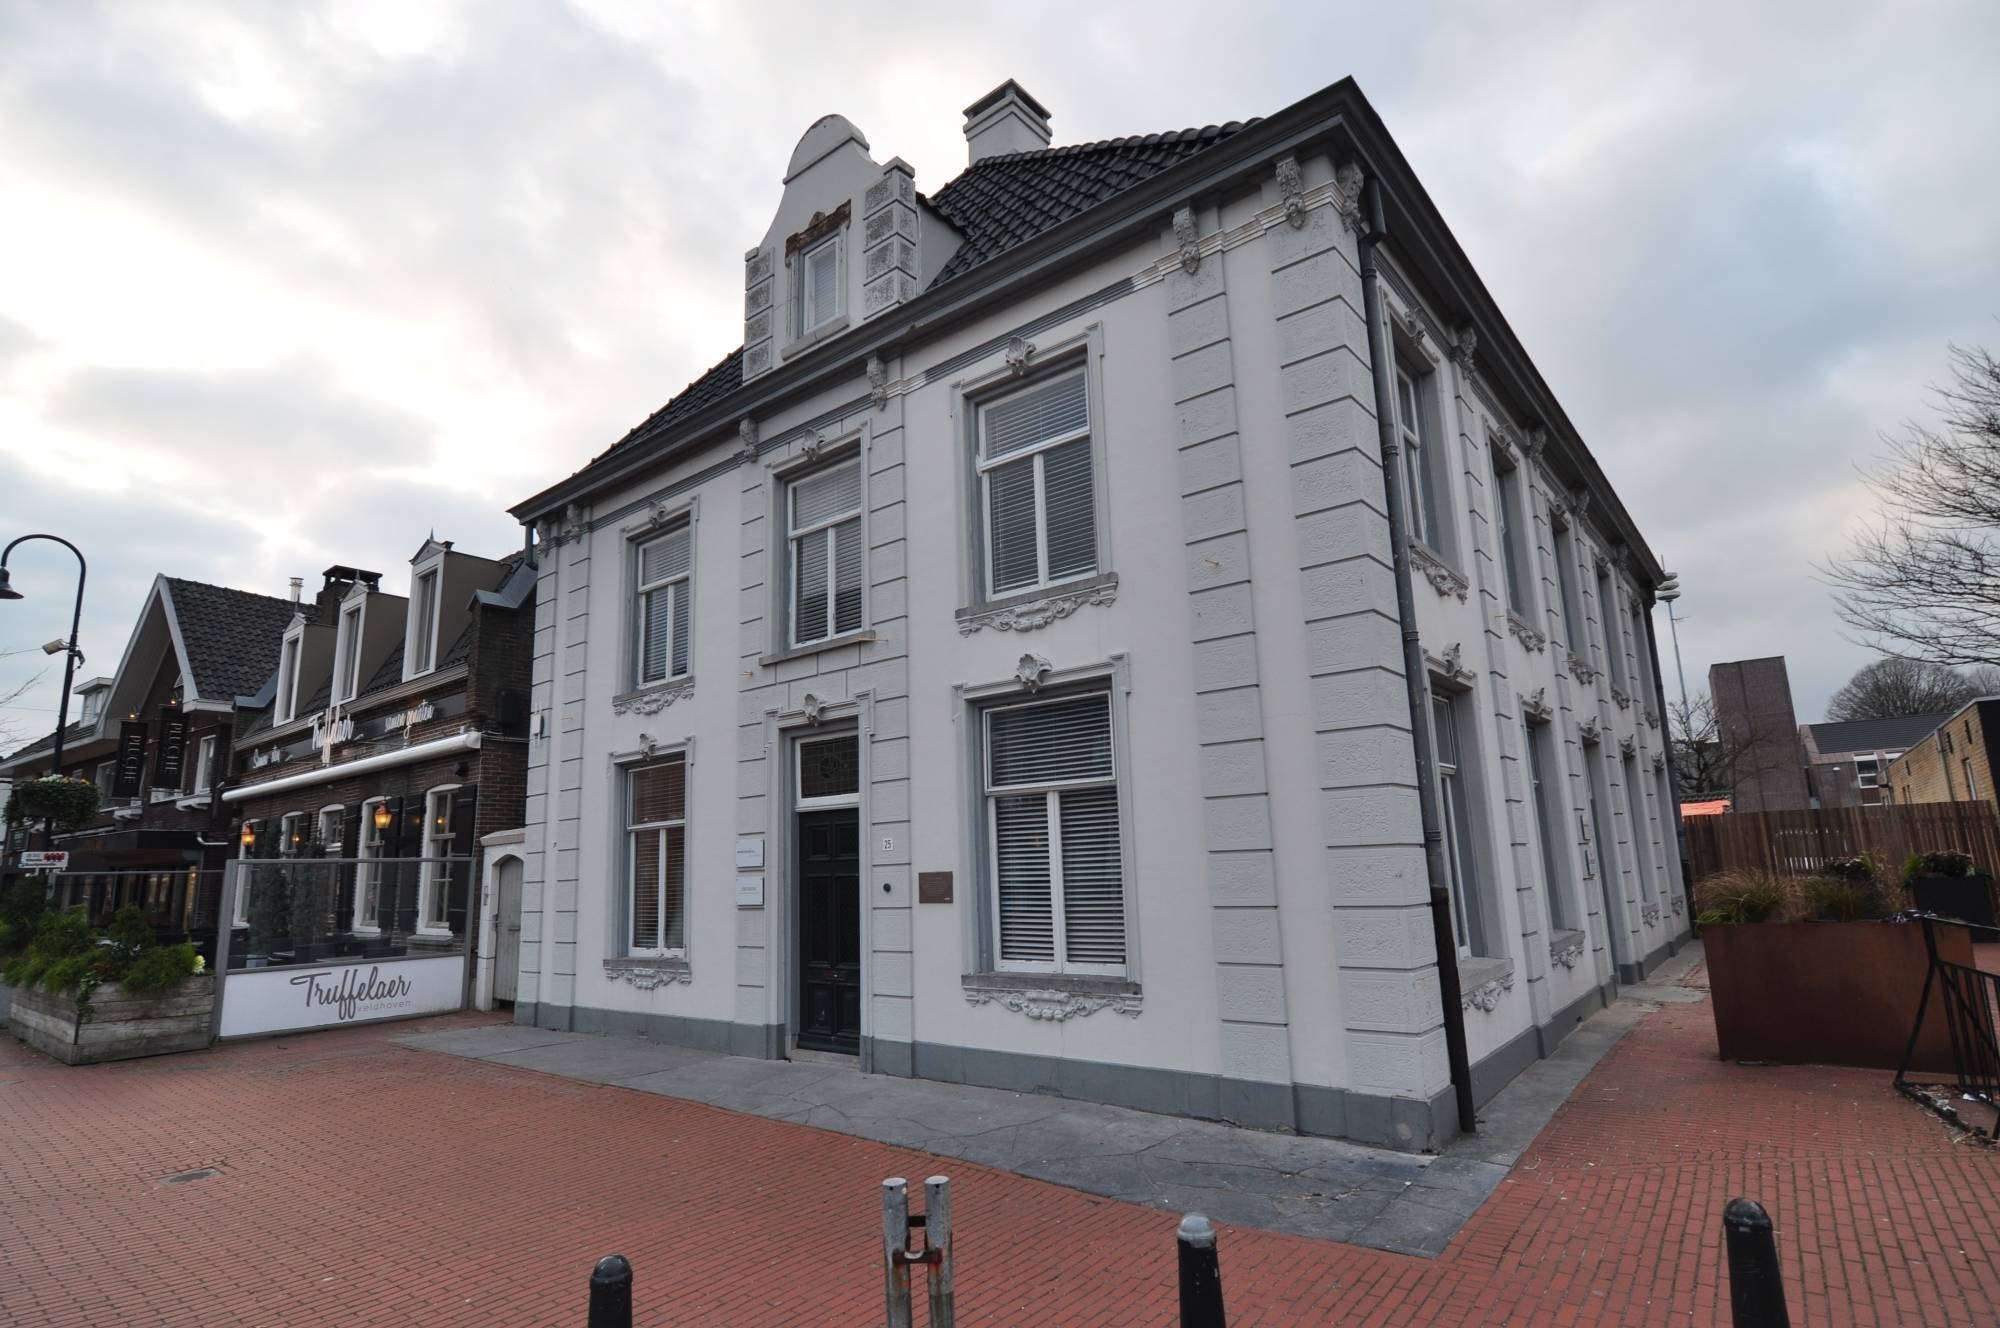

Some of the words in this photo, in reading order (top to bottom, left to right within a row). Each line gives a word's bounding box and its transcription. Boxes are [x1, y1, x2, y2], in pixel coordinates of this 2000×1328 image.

[884, 839, 892, 849] 25
[290, 966, 412, 1020] Truffelaer
[357, 1000, 412, 1012] veldhoven
